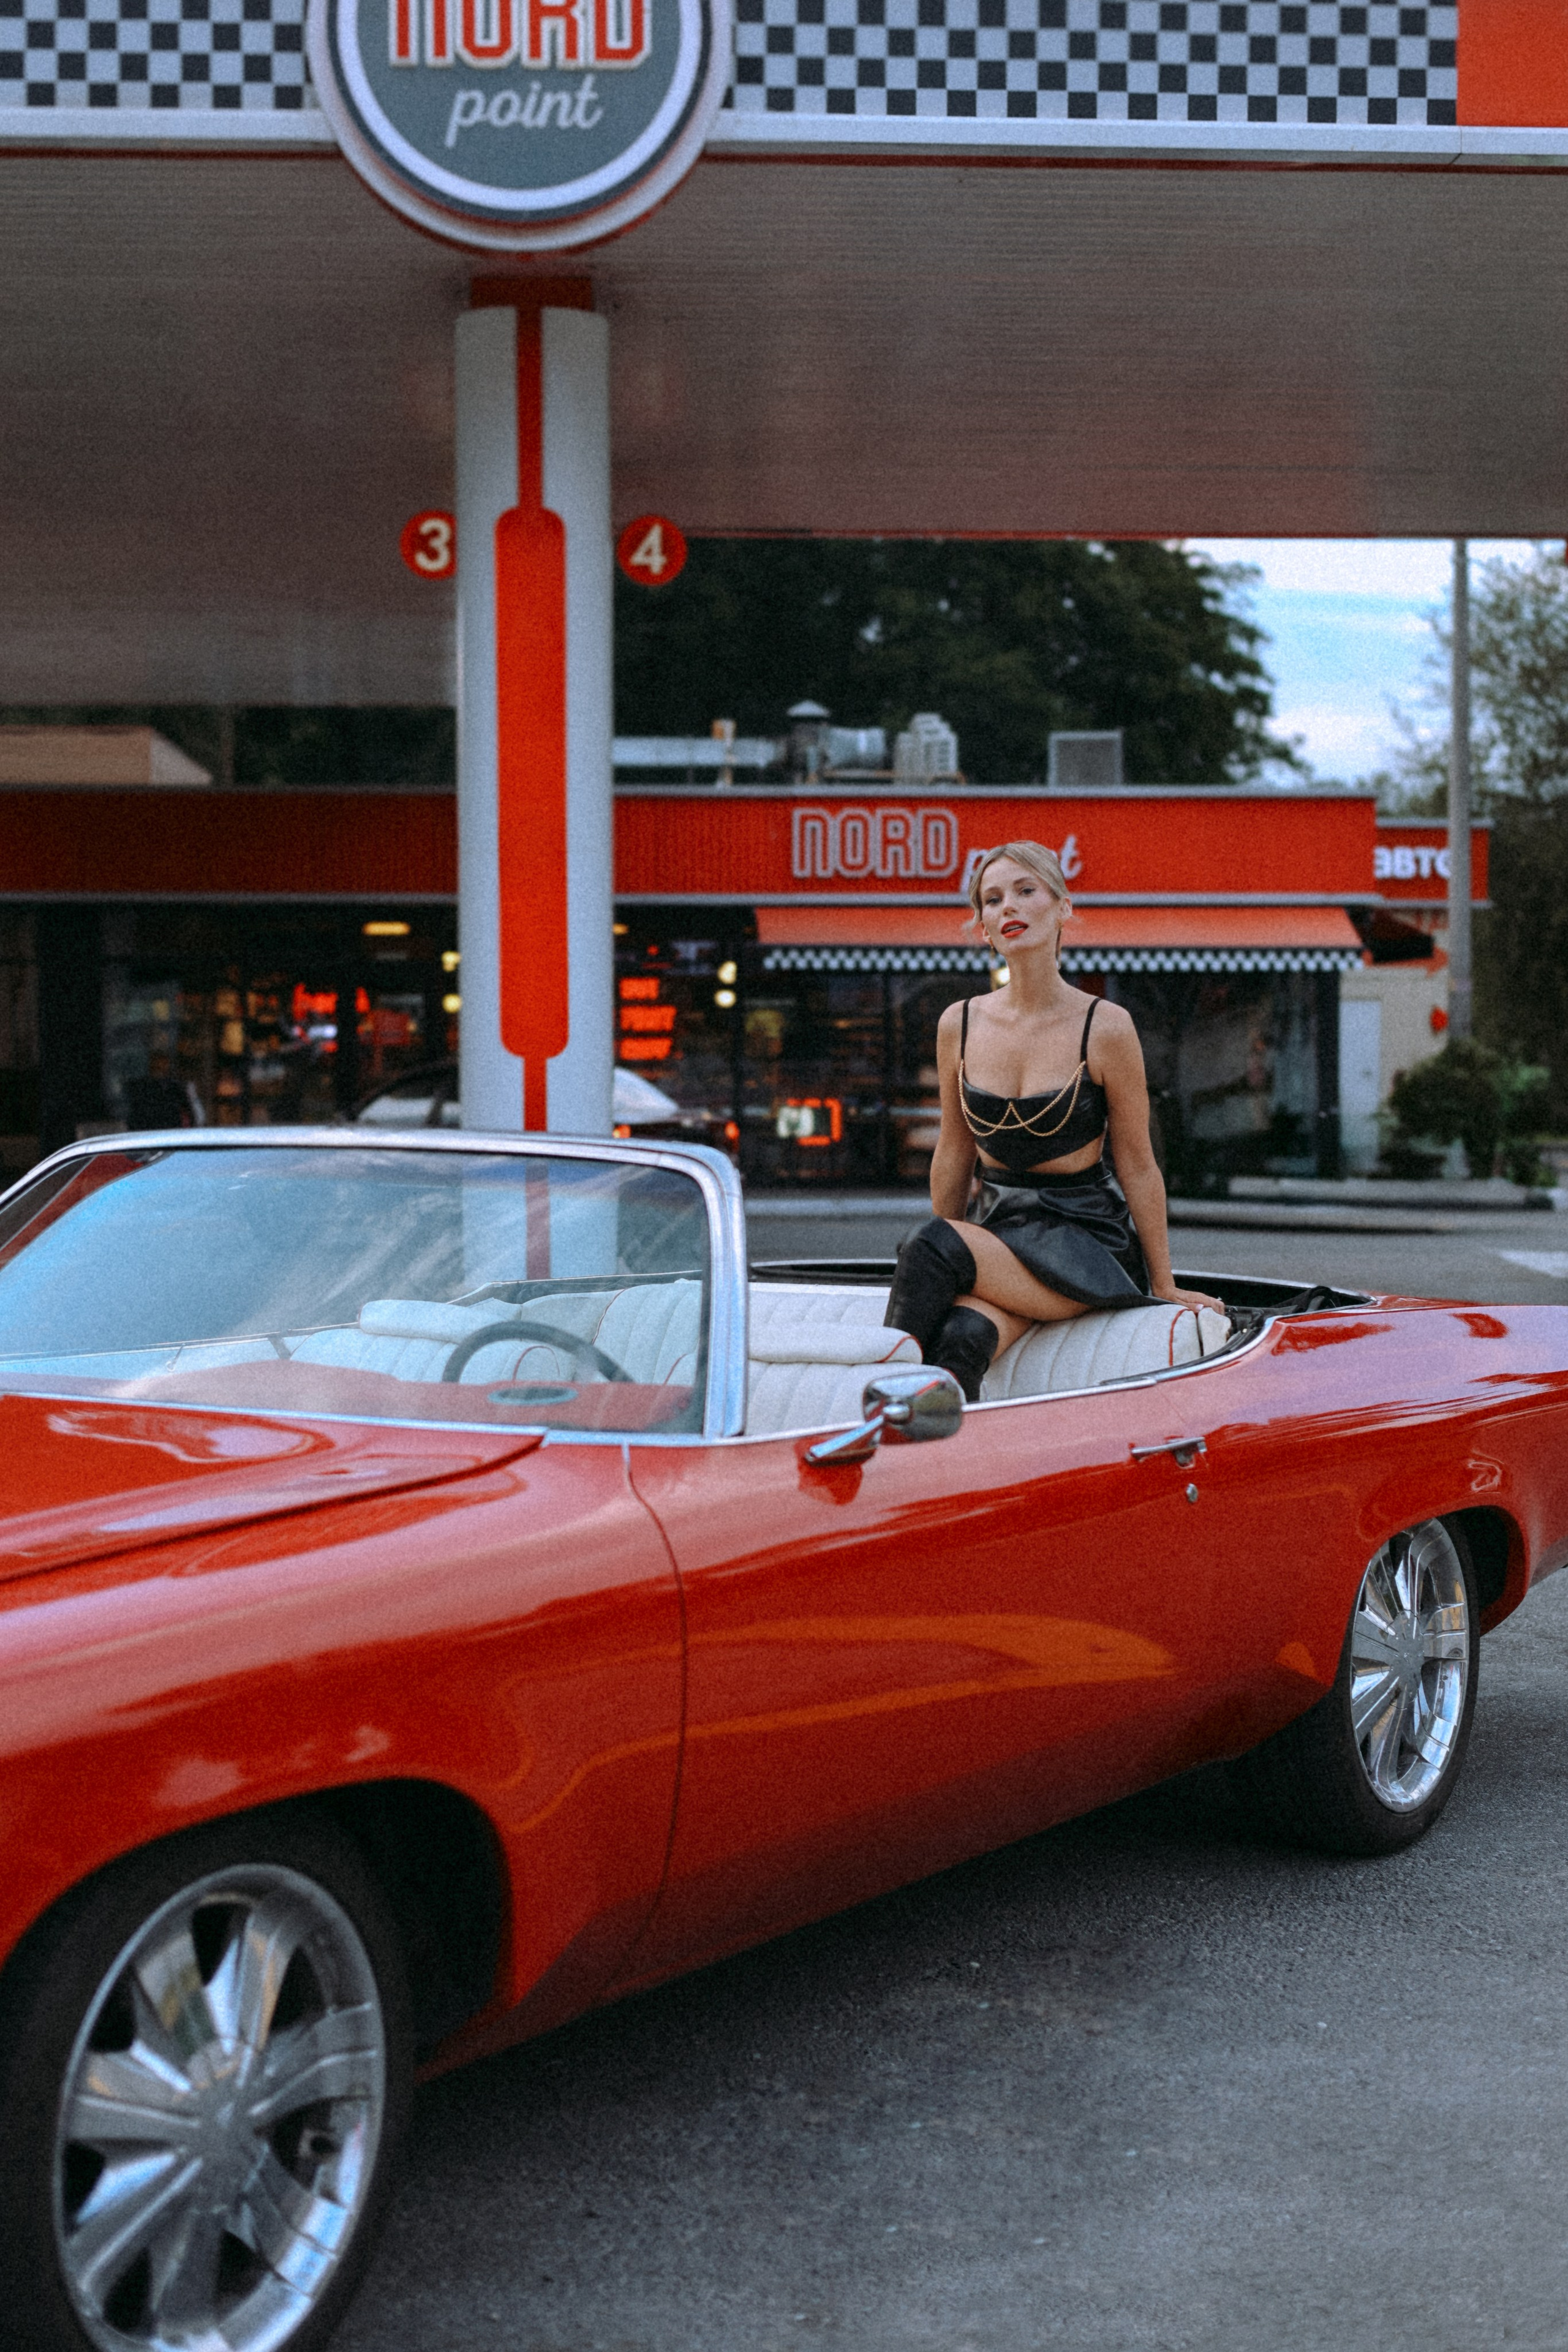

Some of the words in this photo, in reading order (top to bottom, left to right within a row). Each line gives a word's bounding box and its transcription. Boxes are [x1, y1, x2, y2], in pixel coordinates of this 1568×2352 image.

[388, 0, 652, 69] NORD
[445, 74, 605, 148] point
[415, 518, 451, 571] 3
[630, 524, 667, 575] 4
[792, 807, 959, 878] NORD
